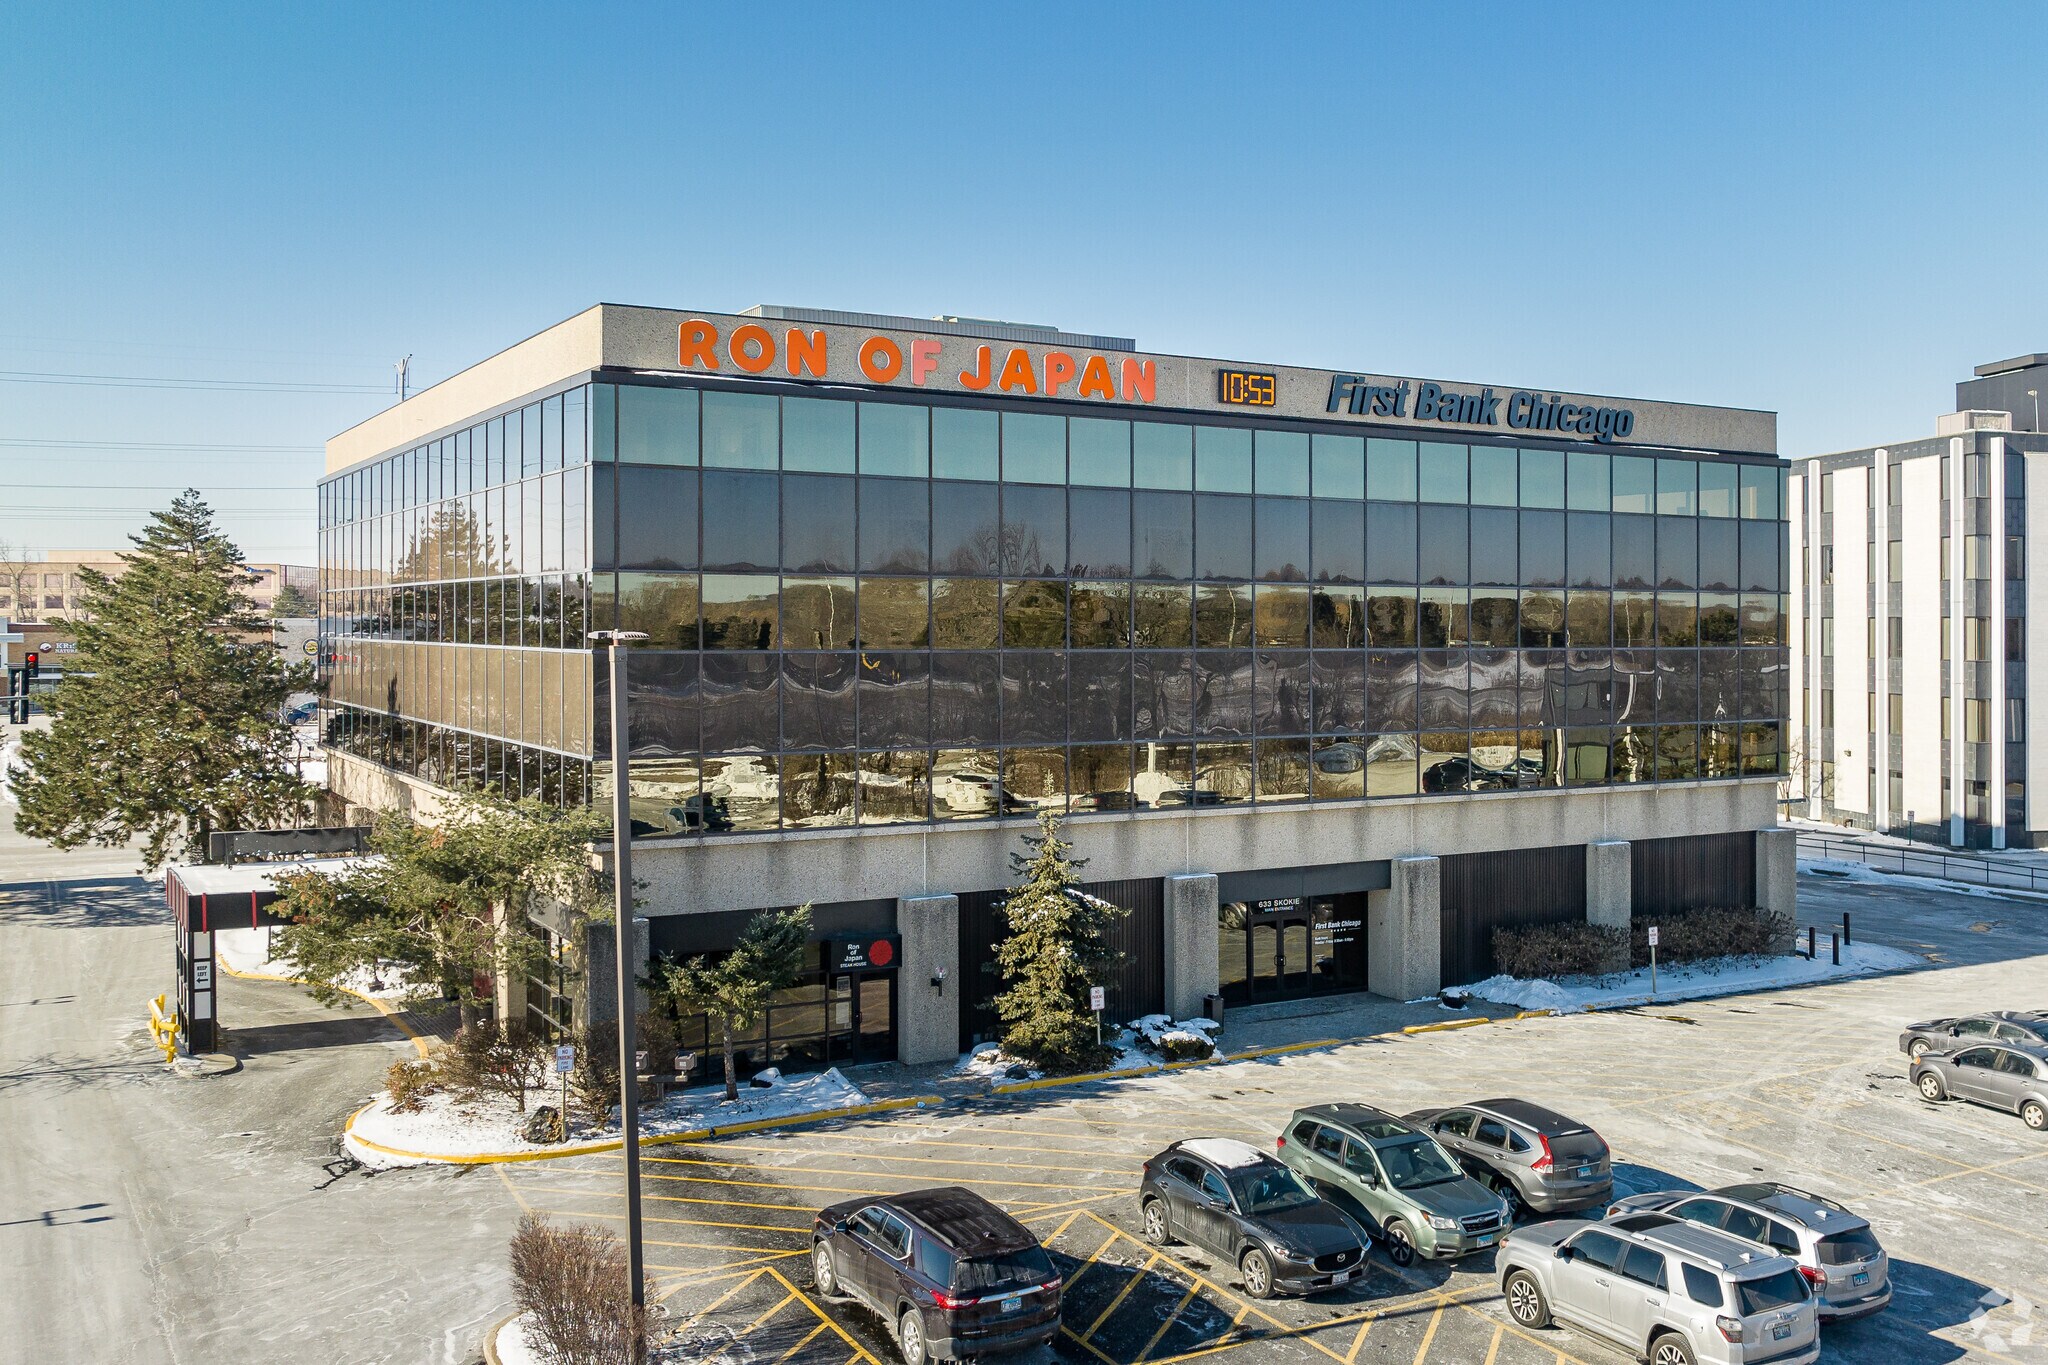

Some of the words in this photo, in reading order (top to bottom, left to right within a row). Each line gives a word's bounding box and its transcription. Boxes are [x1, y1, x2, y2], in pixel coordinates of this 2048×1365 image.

[678, 319, 827, 378] RON
[858, 335, 942, 386] OF
[958, 345, 1157, 403] JAPAN
[1223, 373, 1275, 405] 10:53
[1326, 374, 1411, 418] First
[1413, 381, 1503, 425] Bank
[1507, 390, 1634, 444] Chicago
[1258, 900, 1272, 908] 633
[1273, 897, 1300, 907] SKOKIE
[1315, 922, 1327, 930] First
[1341, 919, 1362, 927] Chicago
[844, 955, 863, 963] Japan
